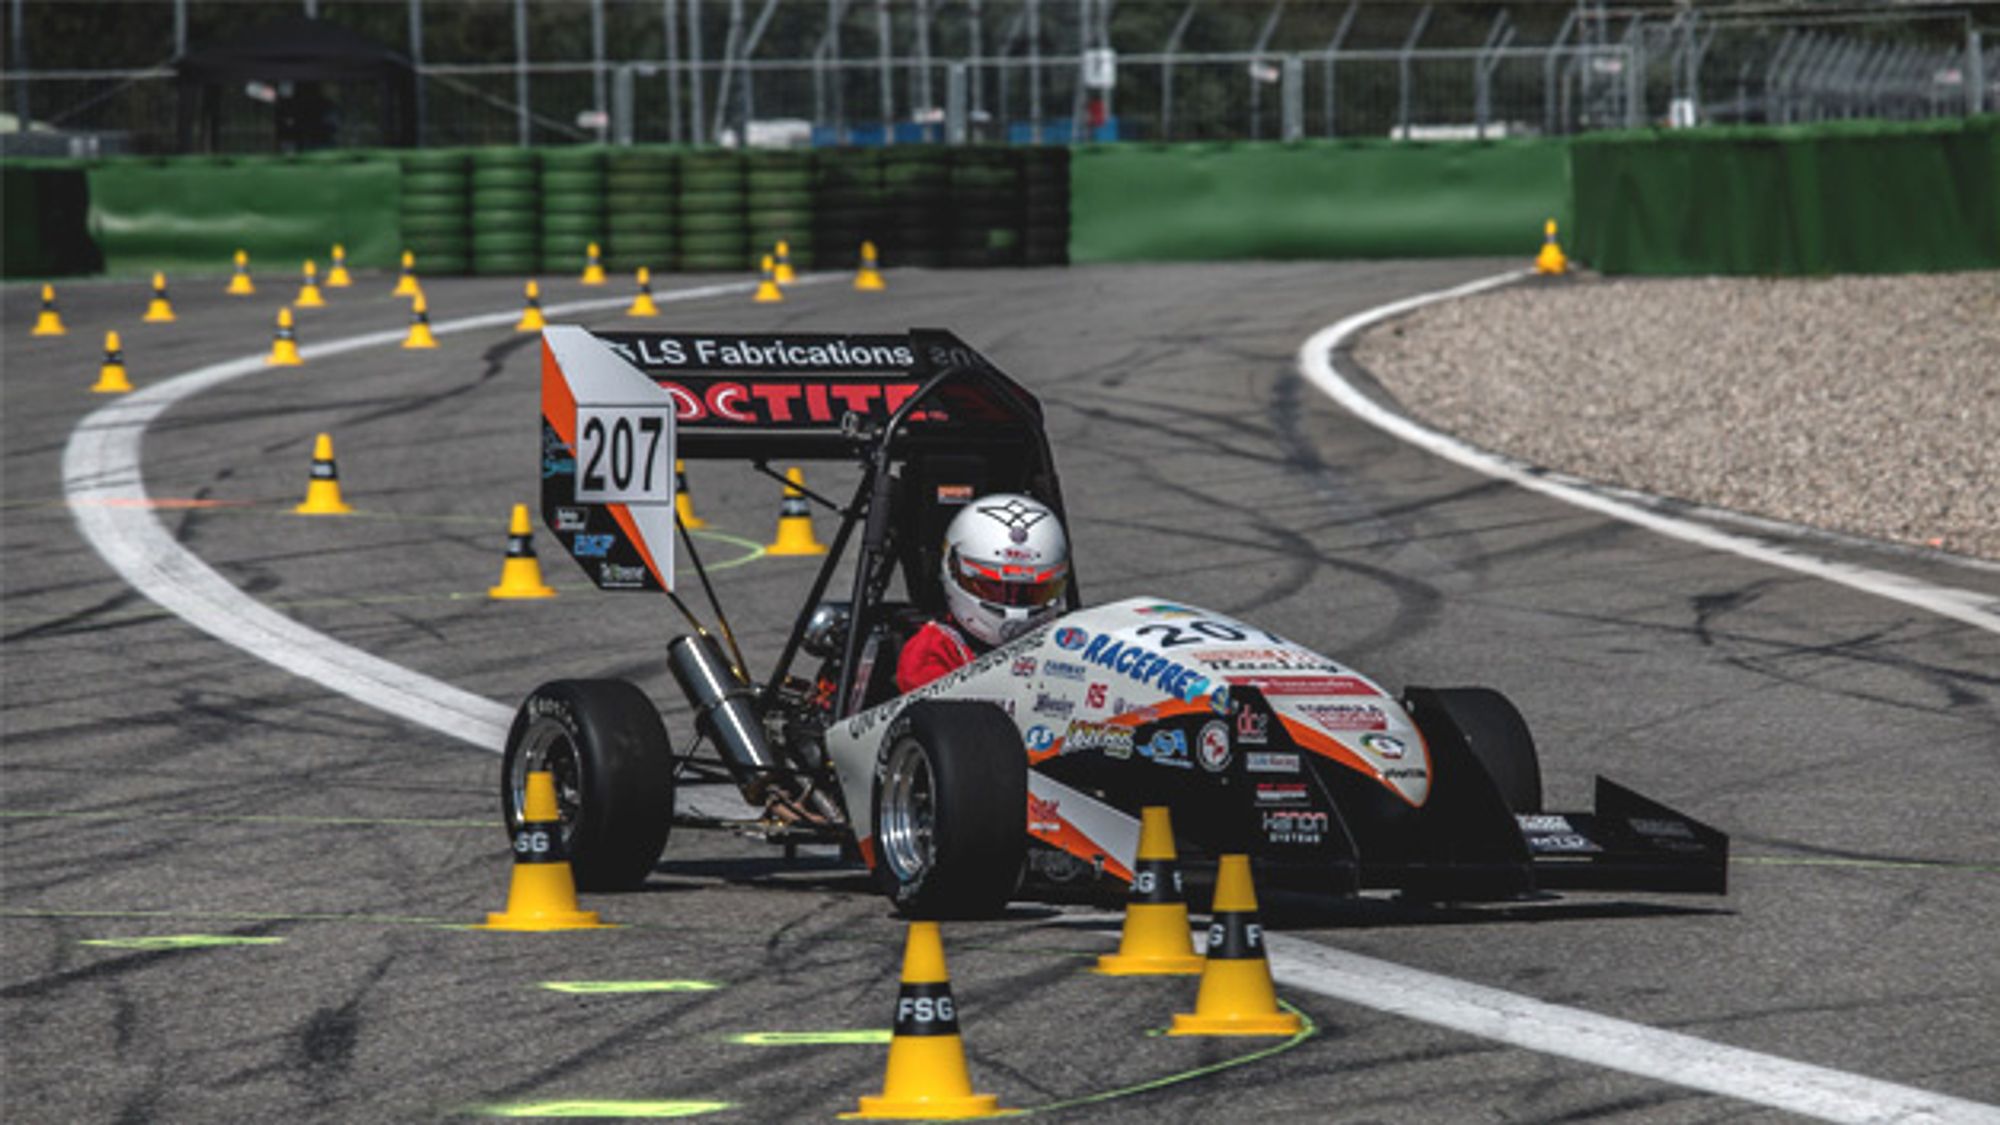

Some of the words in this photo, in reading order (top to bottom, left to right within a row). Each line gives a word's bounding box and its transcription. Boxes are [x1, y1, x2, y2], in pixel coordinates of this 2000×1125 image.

[695, 340, 914, 366] Fabrications
[582, 417, 663, 492] 207
[1136, 620, 1284, 648] 20
[1082, 633, 1210, 701] RACEPRE
[898, 997, 955, 1022] FSG
